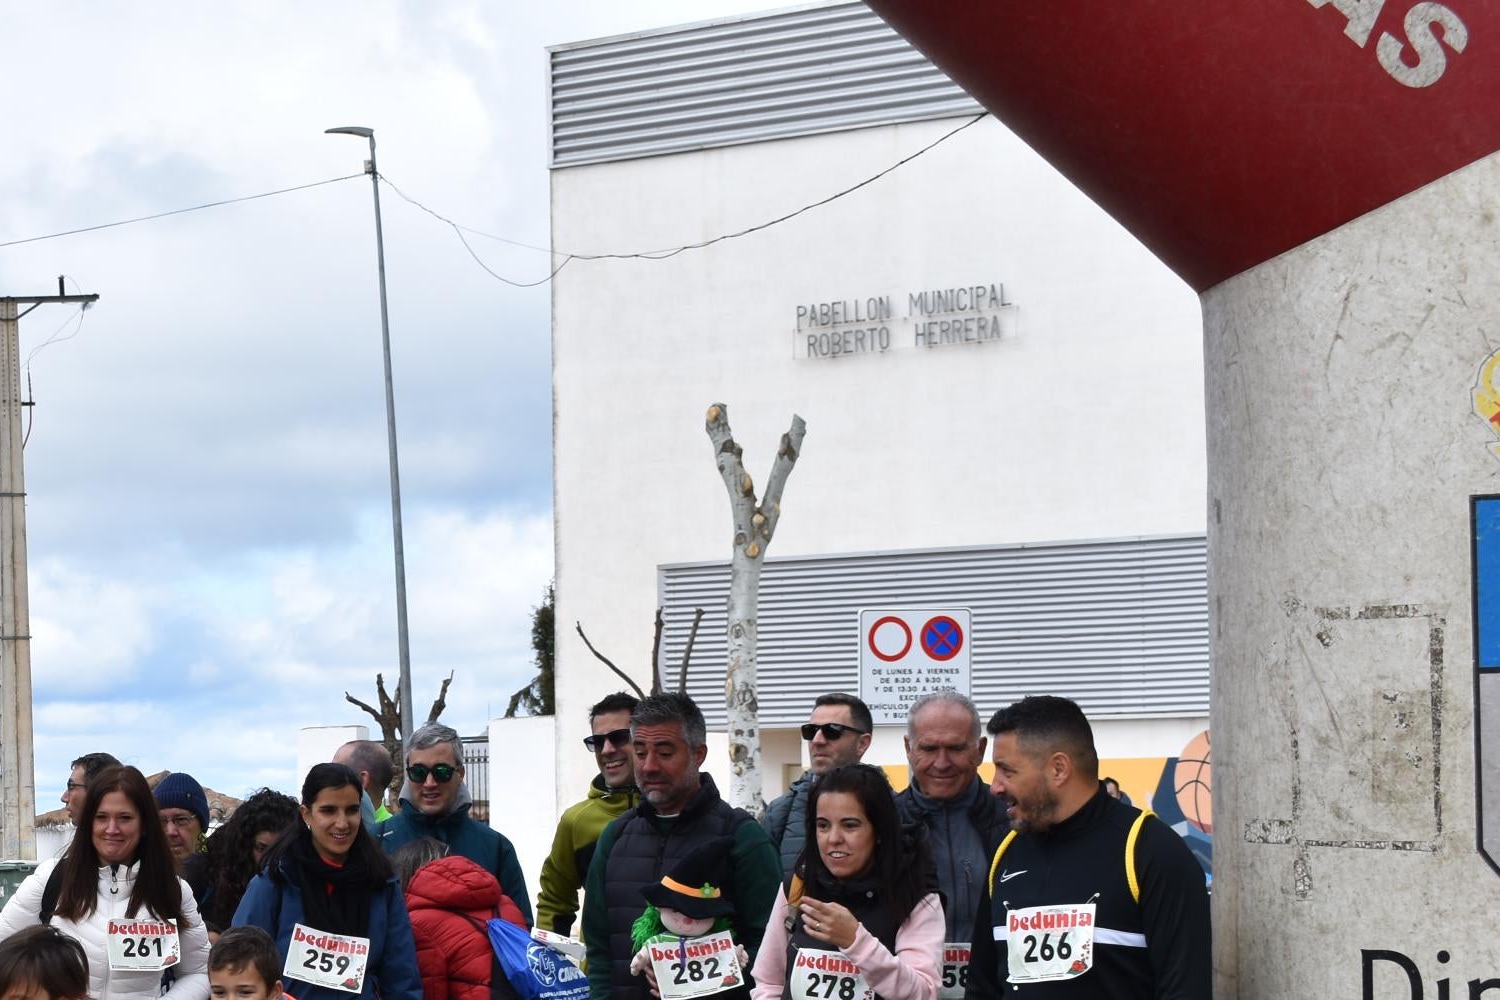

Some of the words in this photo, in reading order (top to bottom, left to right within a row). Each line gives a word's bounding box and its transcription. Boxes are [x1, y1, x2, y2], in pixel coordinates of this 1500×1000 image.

[796, 296, 891, 329] PABELLON
[908, 283, 1013, 316] MUNICIPAL
[806, 327, 890, 358] ROBERTO
[914, 315, 1002, 347] HERRERA
[108, 921, 177, 935] bedunia
[1009, 909, 1092, 933] bedunia
[122, 937, 163, 958] 261
[293, 927, 368, 956] bedunia
[1023, 931, 1072, 964] 266
[302, 948, 350, 976] 259
[670, 957, 723, 985] 282
[805, 972, 856, 1000] 278
